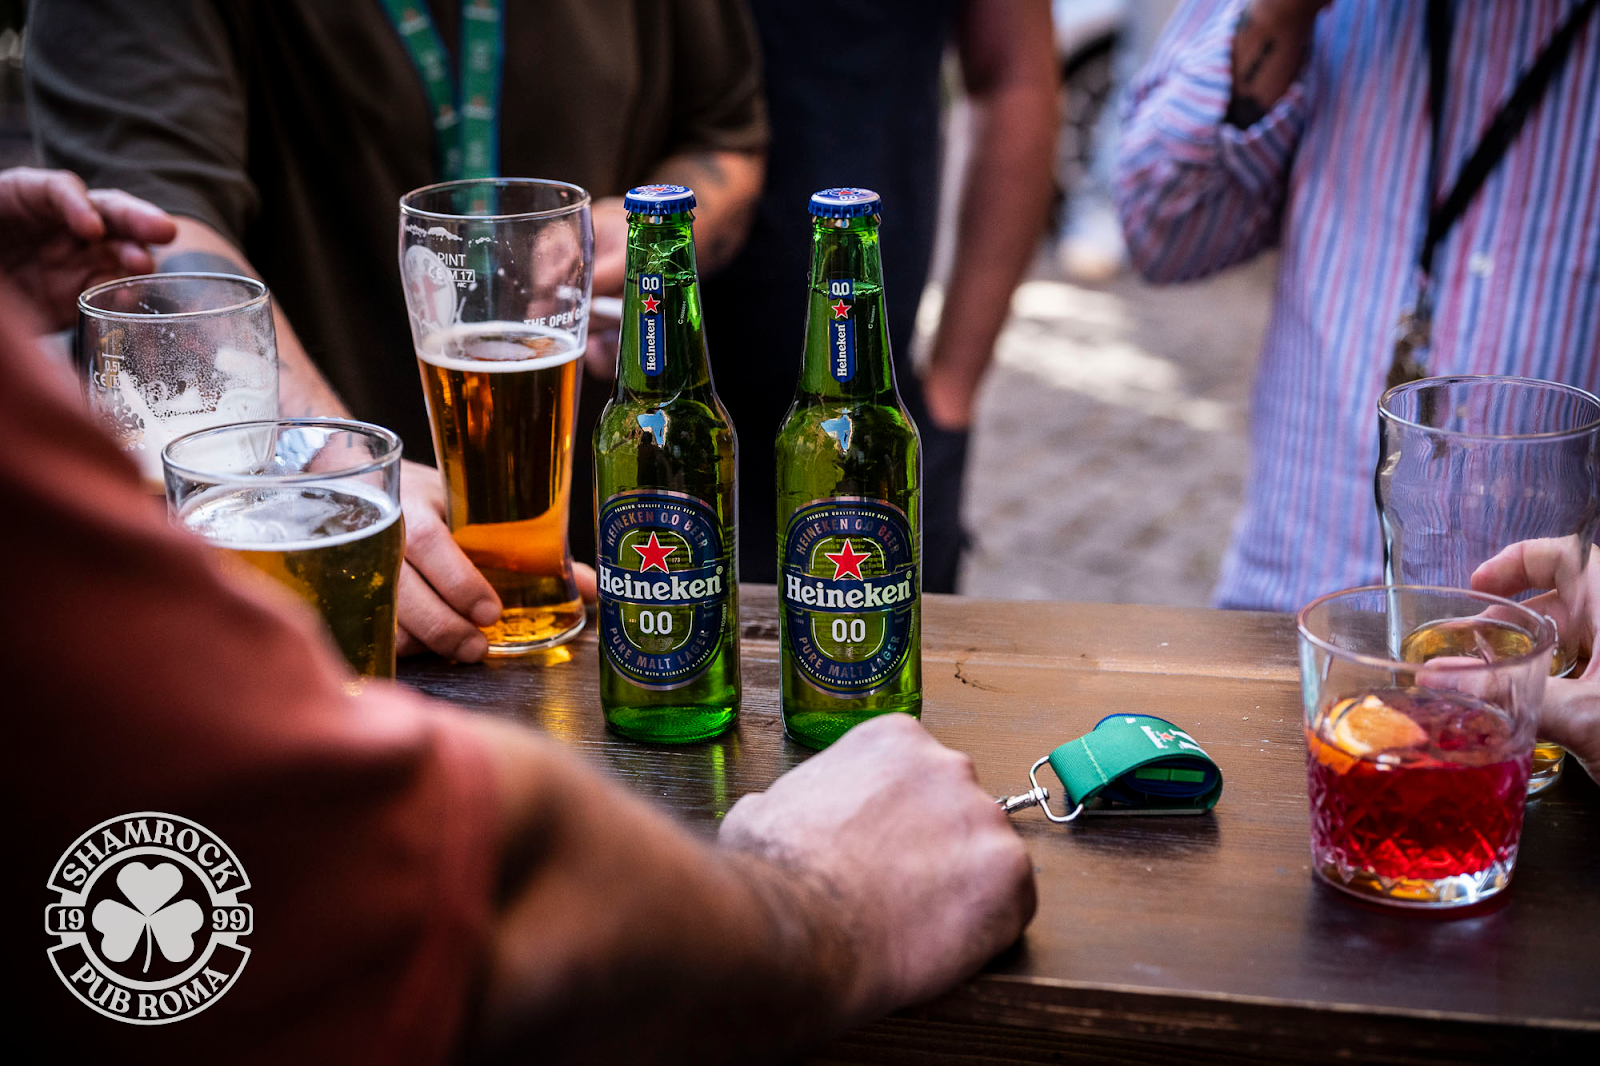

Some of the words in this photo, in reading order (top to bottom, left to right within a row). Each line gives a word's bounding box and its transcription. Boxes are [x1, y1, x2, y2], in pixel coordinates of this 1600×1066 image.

[437, 252, 466, 267] PINT
[460, 272, 473, 281] 17
[642, 276, 660, 291] 0.0
[831, 282, 850, 296] 0.0
[549, 310, 575, 328] OPEN
[645, 318, 657, 371] Heineken
[836, 323, 848, 377] Heineken
[606, 510, 654, 547] HEINEKEN
[683, 519, 708, 549] BEER
[796, 518, 848, 555] HEINEKEN
[877, 524, 900, 555] BEER
[600, 564, 723, 601] Heineken
[786, 572, 912, 608] Heineken
[640, 611, 672, 635] 0.0
[831, 619, 866, 643] 0.0
[609, 627, 632, 660] PURE
[636, 655, 671, 670] MALT
[677, 629, 709, 665] LAGER
[798, 636, 824, 670] PURE
[828, 664, 864, 679] MALT
[869, 635, 900, 673] LAGER
